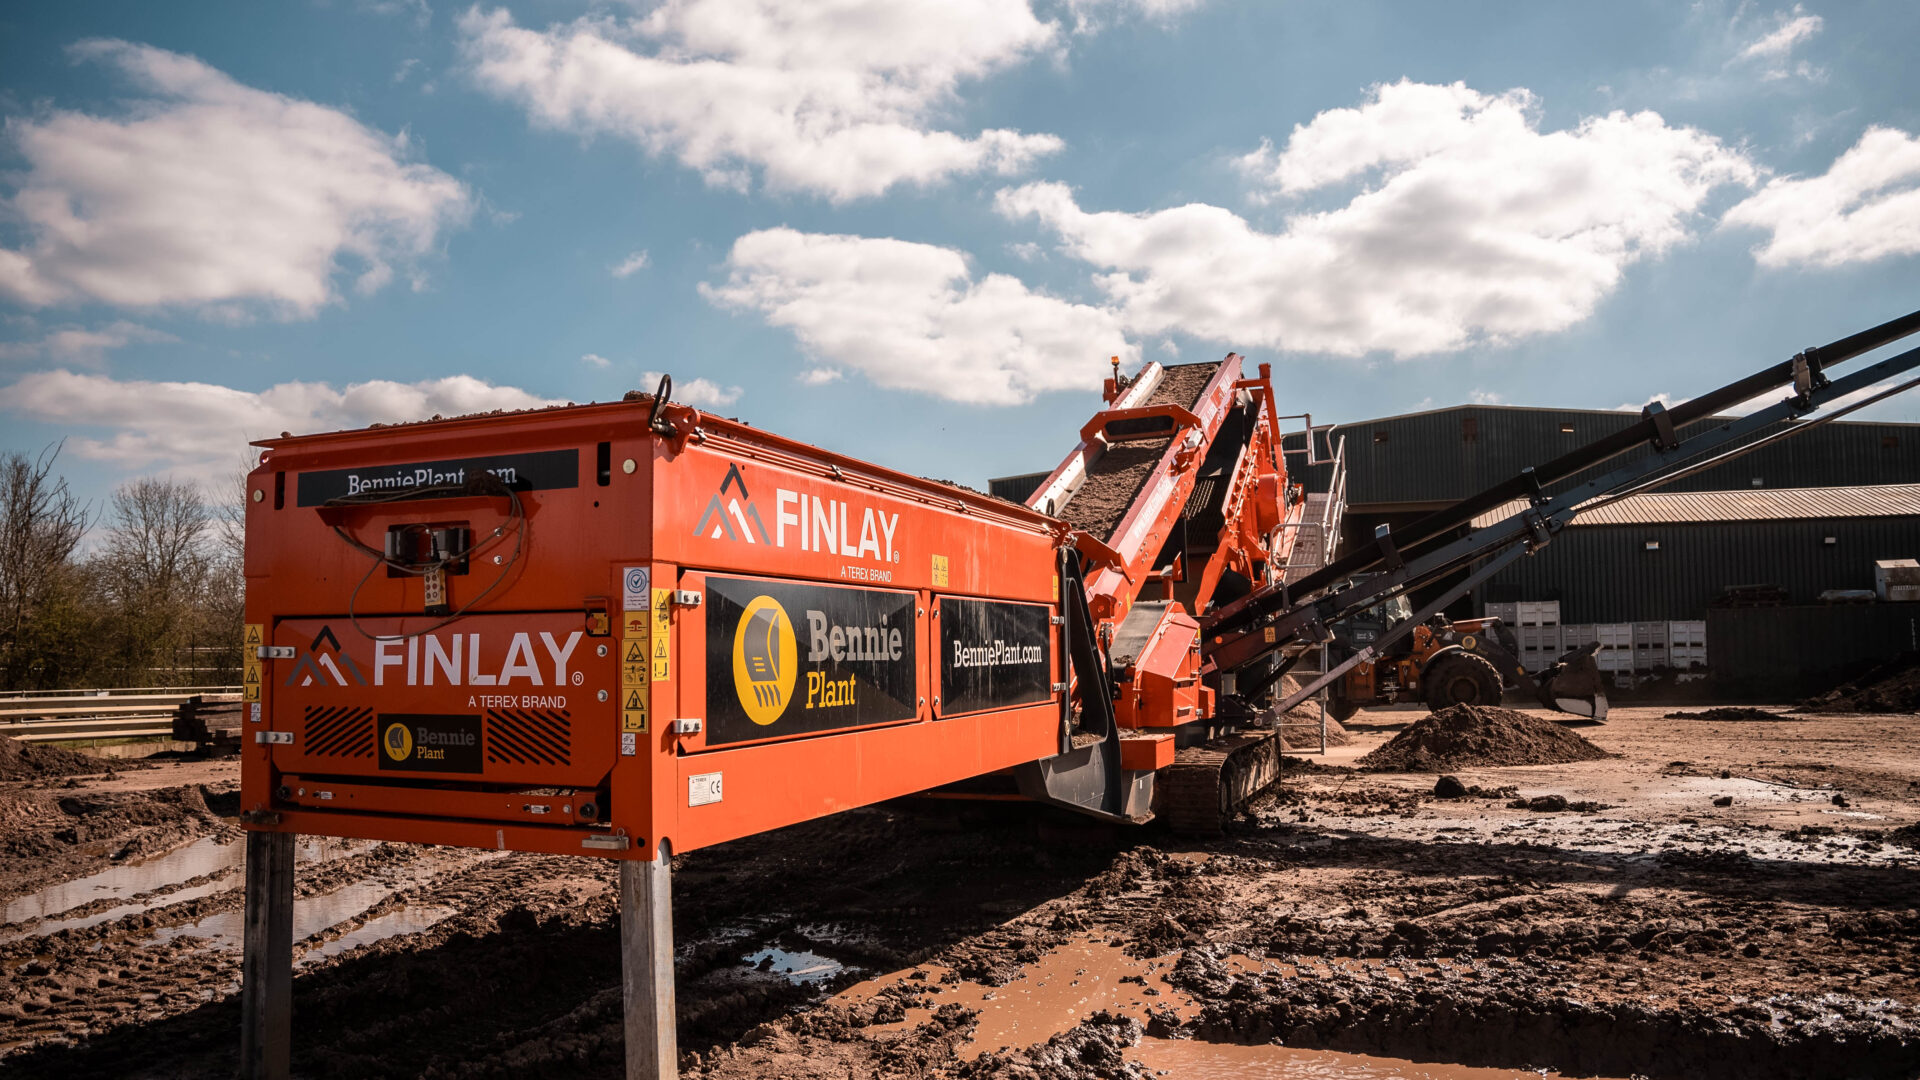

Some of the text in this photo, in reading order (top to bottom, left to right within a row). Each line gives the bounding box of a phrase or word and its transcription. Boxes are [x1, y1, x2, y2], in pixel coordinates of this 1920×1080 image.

[841, 565, 892, 582] A TEREX BRAND
[806, 610, 902, 661] Bennie
[953, 639, 1042, 668] BenniePlant.com
[805, 671, 856, 709] Plant
[468, 695, 567, 709] A TEREX BRAND
[417, 727, 475, 746] Bennie
[417, 746, 445, 760] Plant
